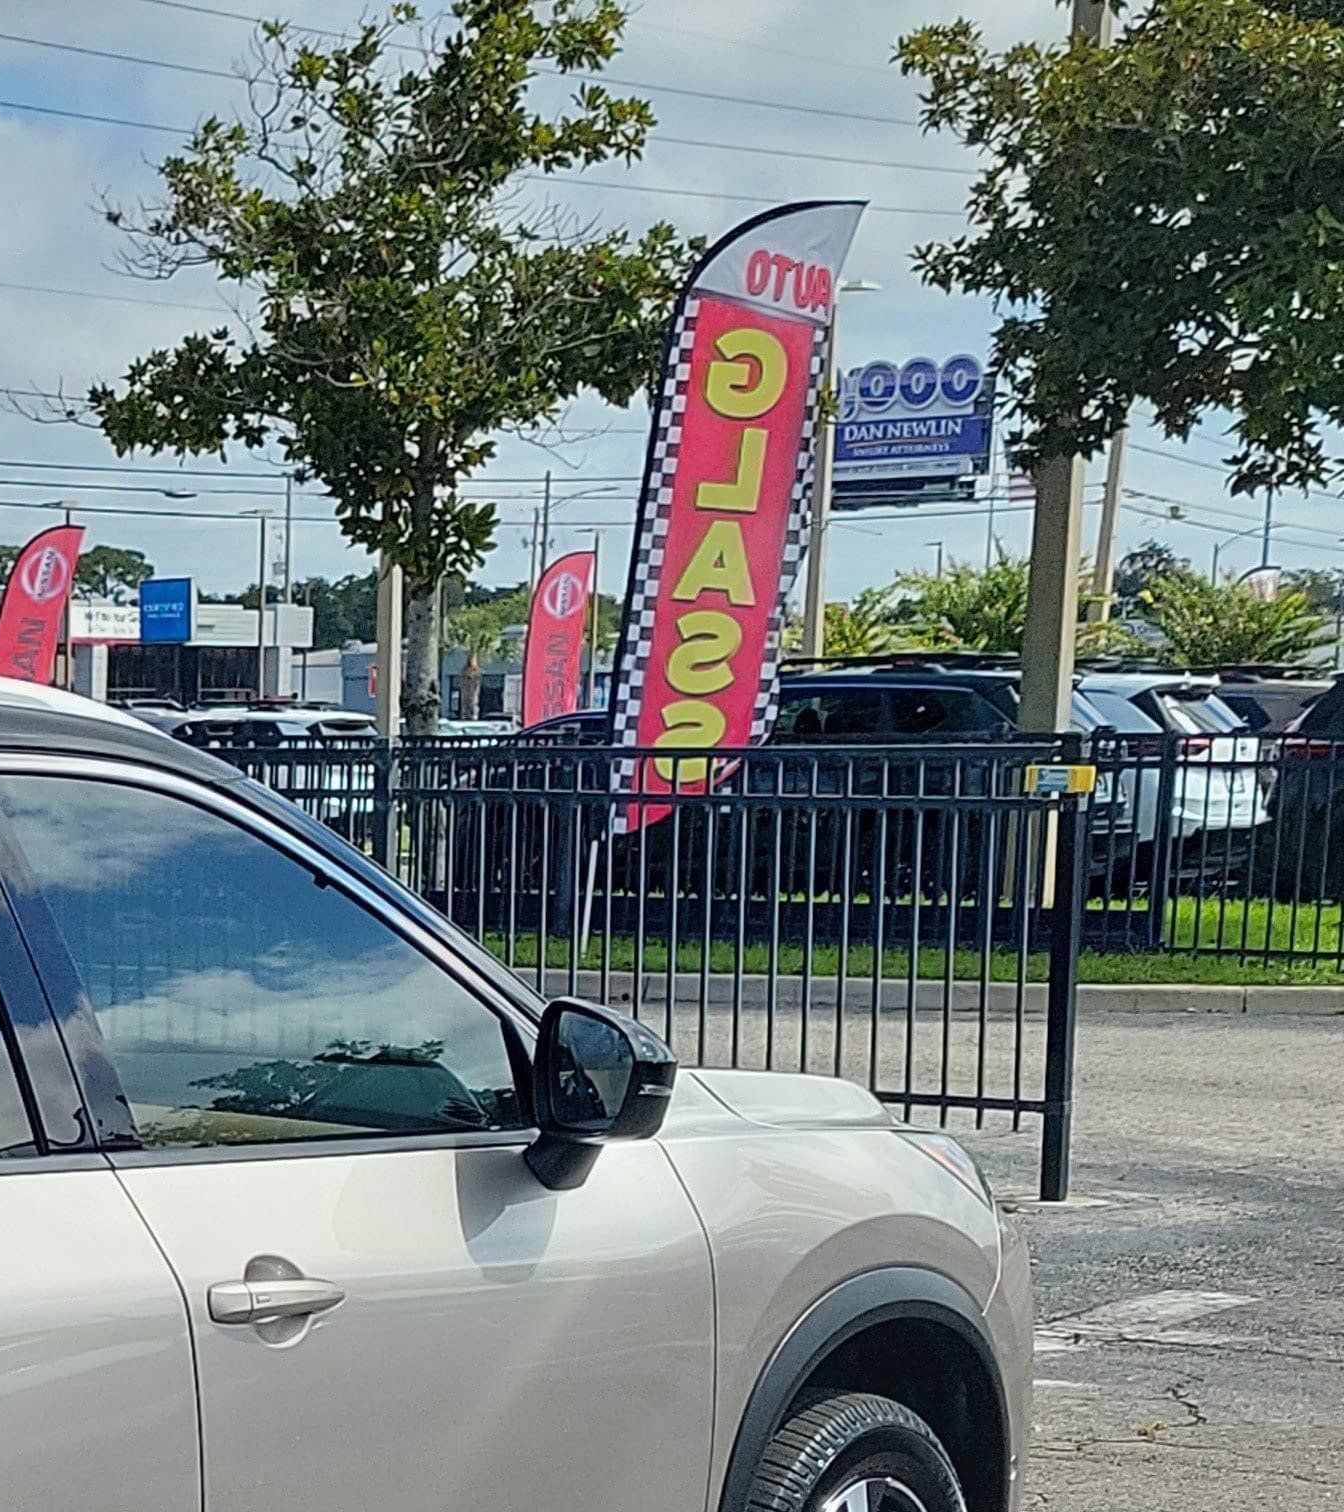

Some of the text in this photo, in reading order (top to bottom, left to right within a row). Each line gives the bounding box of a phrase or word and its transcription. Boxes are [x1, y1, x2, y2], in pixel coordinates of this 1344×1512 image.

[836, 354, 985, 424] ,000
[843, 418, 962, 442] DAN NEWLIN
